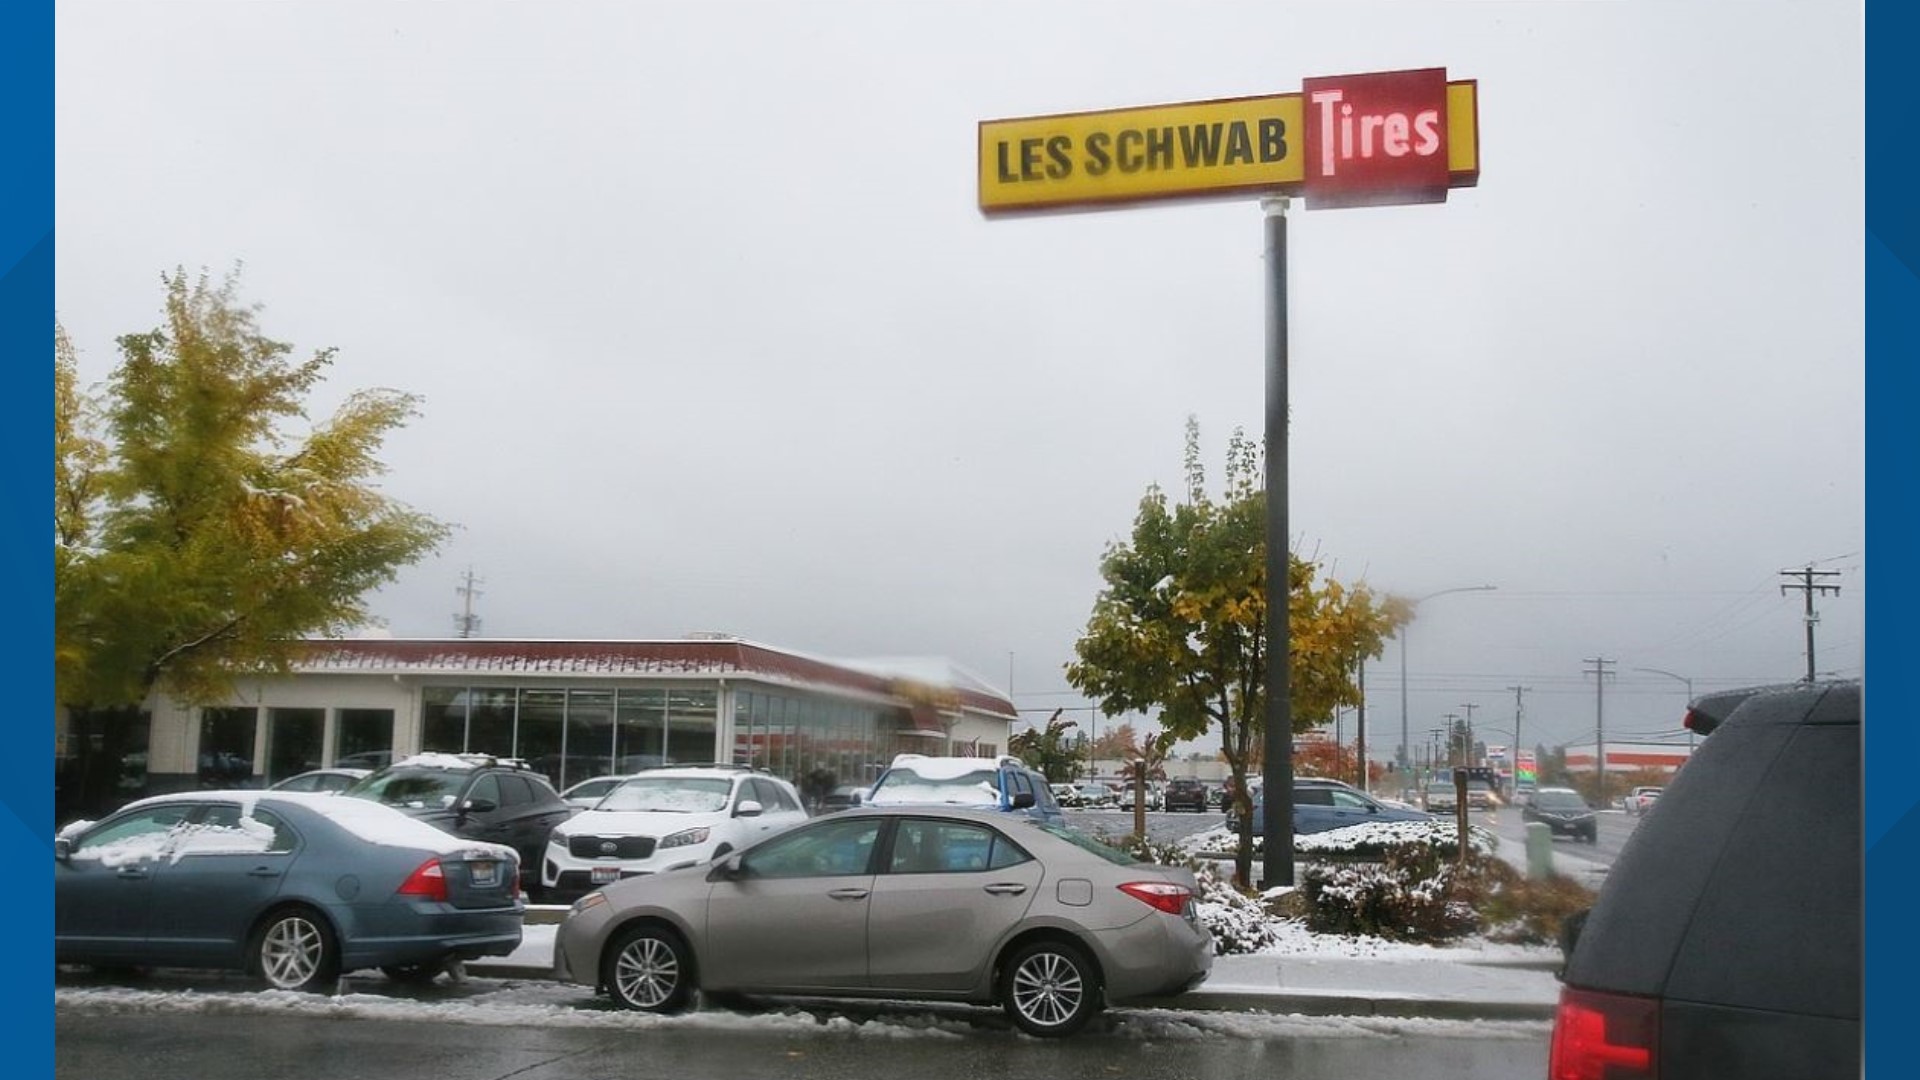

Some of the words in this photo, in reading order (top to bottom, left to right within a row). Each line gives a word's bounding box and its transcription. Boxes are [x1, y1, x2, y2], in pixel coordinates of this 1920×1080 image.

[997, 135, 1073, 183] LES
[1085, 118, 1287, 176] SCHWAB
[1312, 89, 1439, 176] Tires
